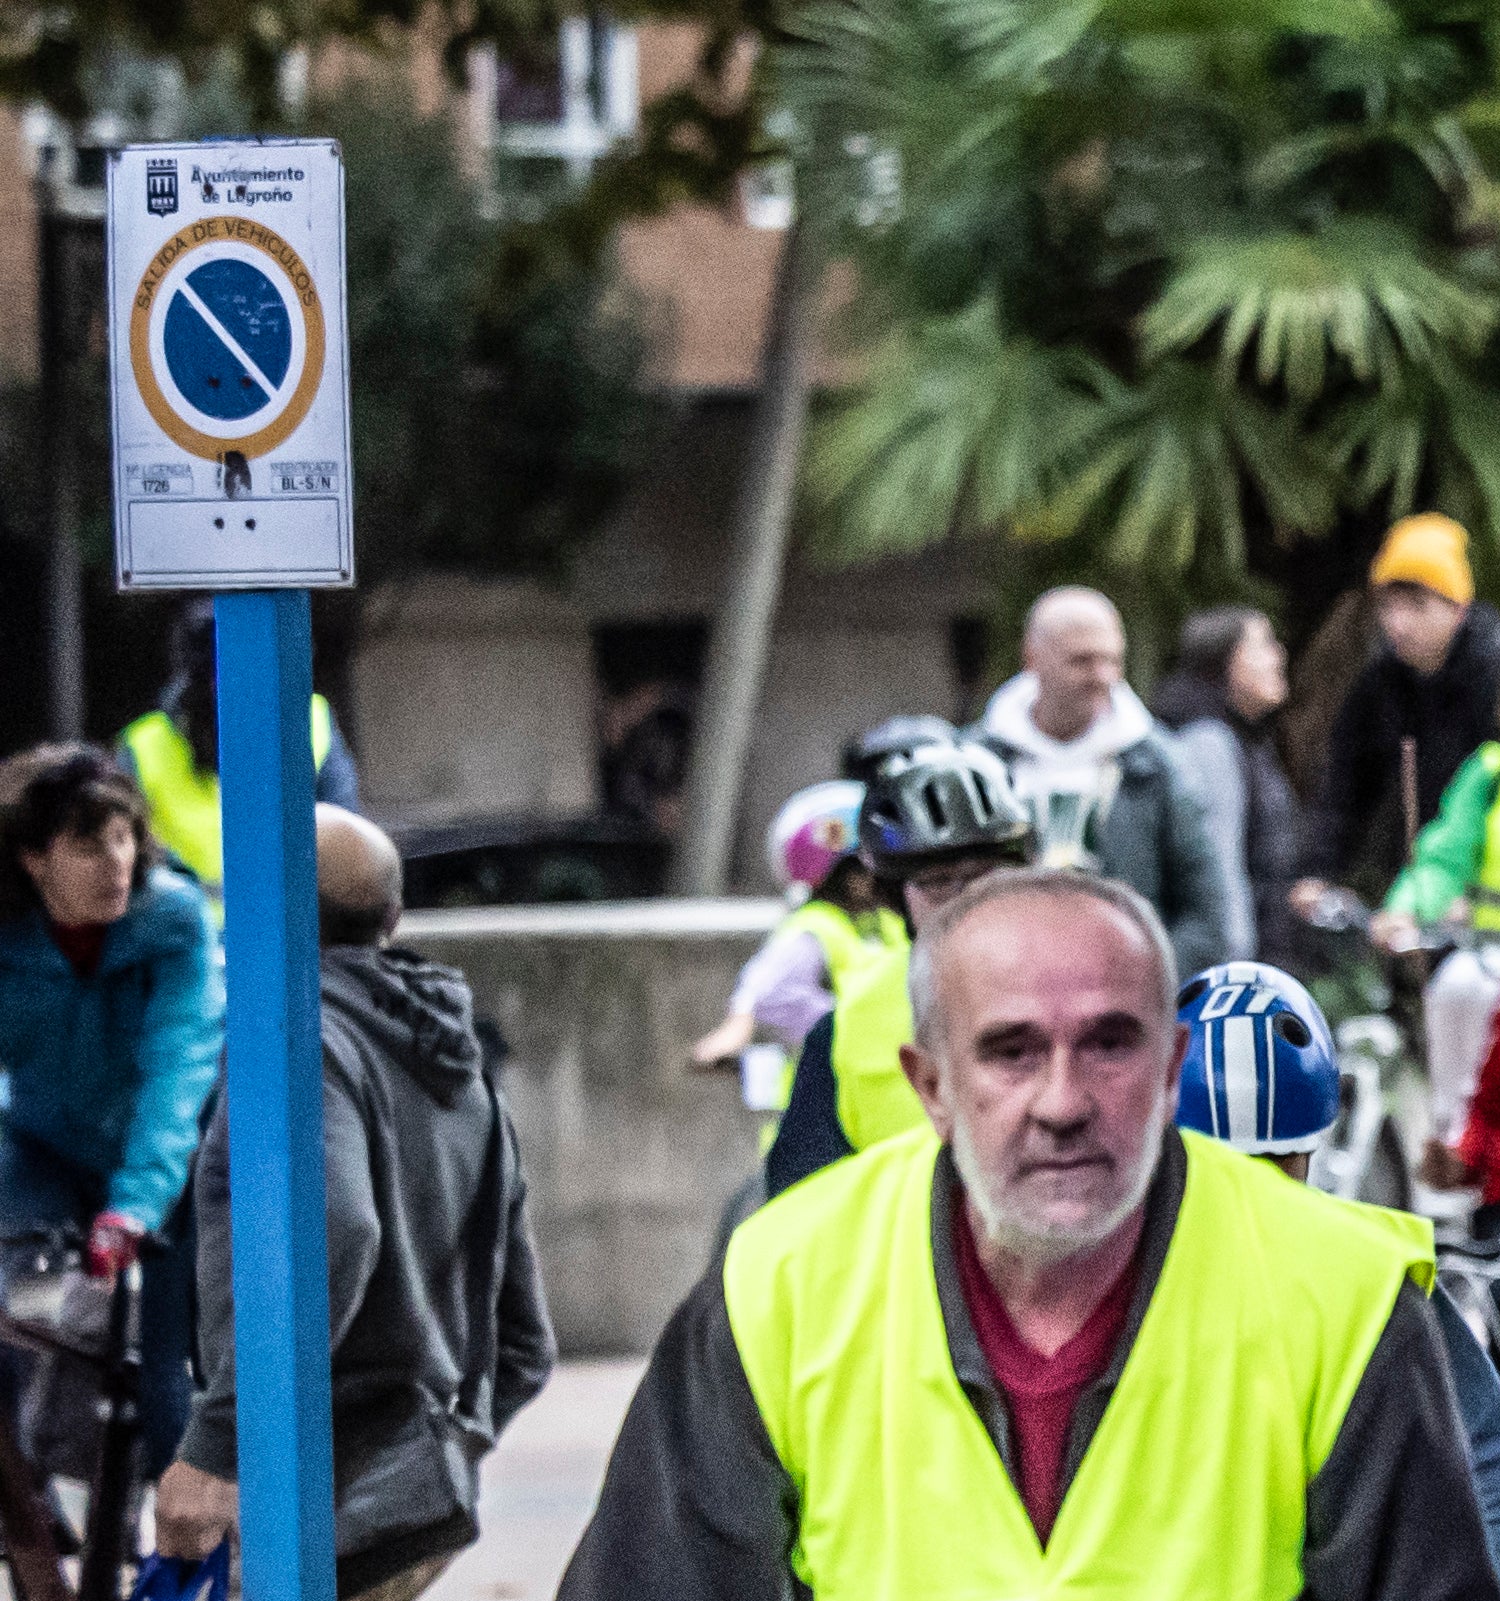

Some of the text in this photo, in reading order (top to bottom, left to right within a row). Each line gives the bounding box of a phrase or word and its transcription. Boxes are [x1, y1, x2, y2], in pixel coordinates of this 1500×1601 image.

[190, 165, 305, 184] Ayuntamiento
[227, 187, 293, 206] Logroño
[137, 219, 317, 311] SALIDA DE VEHICULOS
